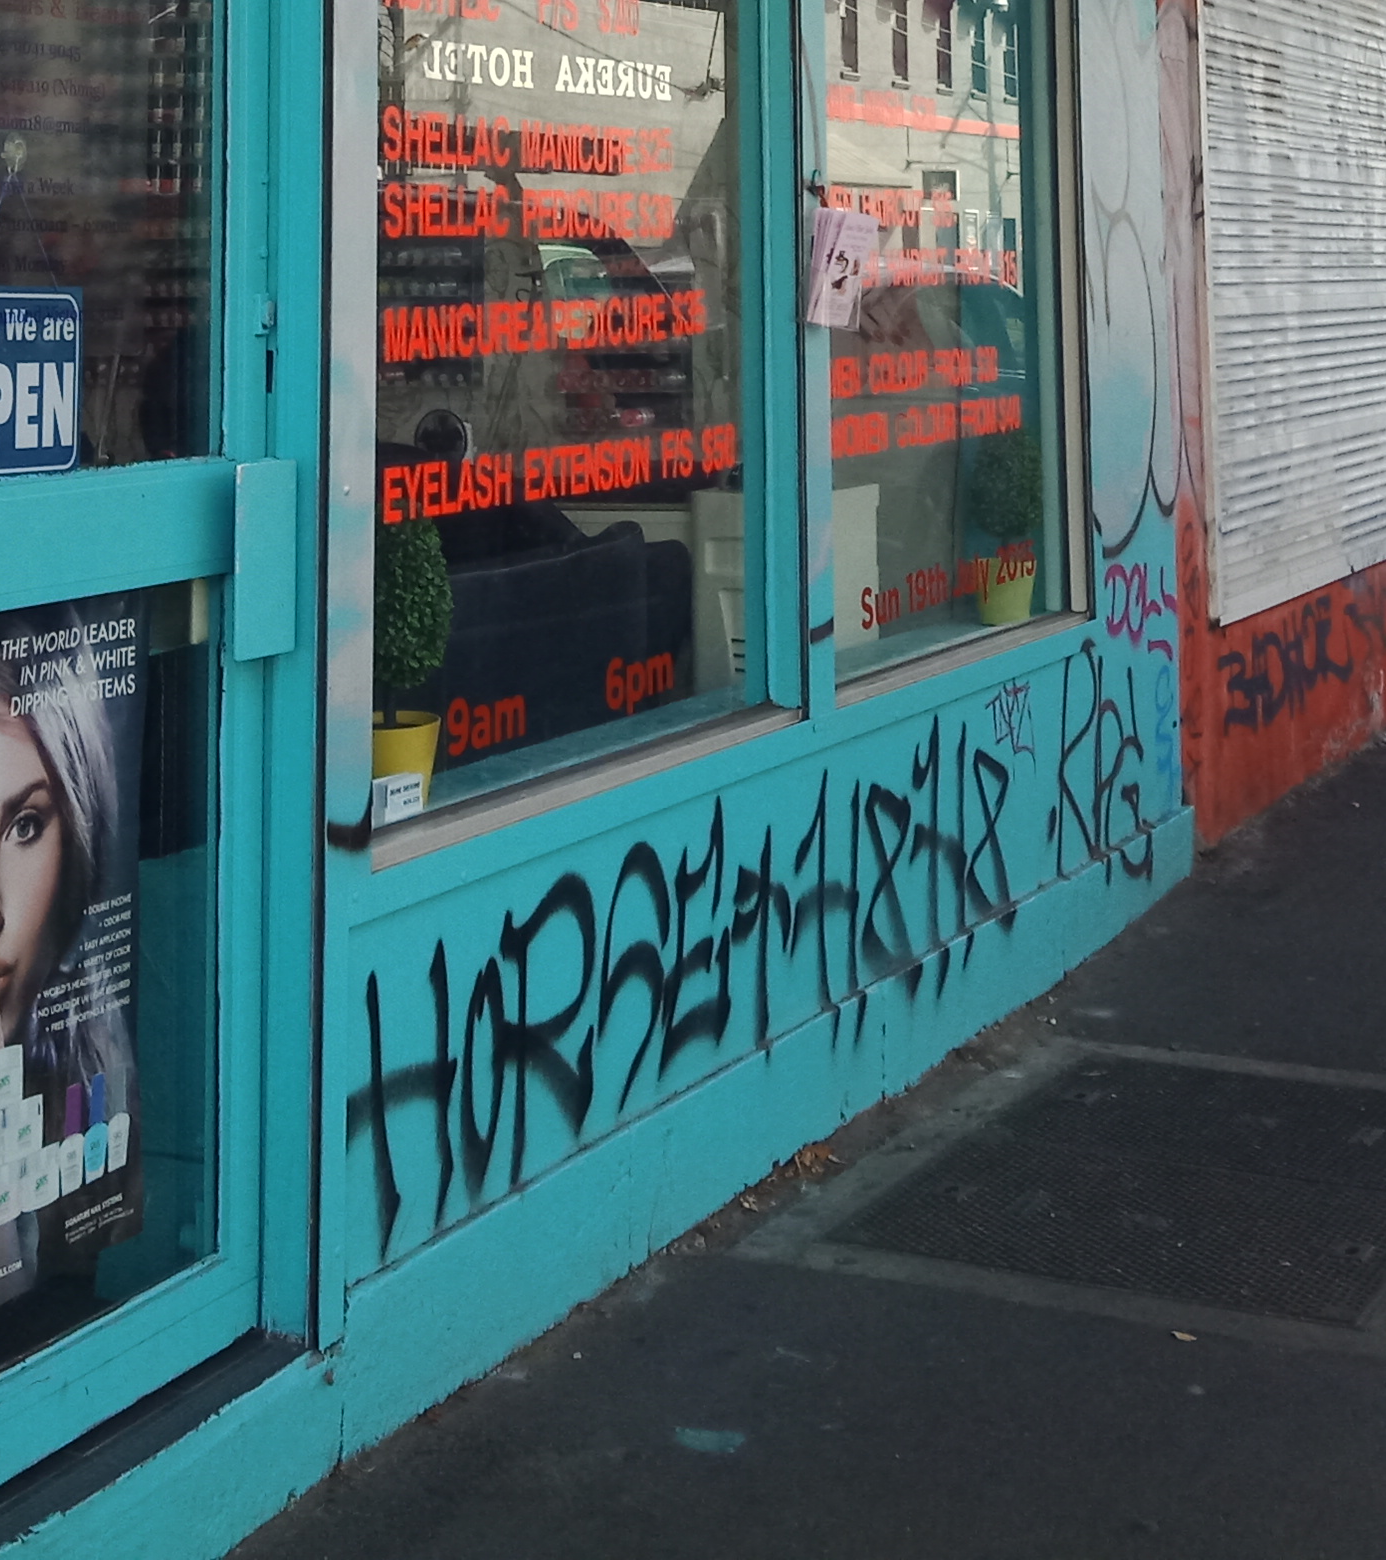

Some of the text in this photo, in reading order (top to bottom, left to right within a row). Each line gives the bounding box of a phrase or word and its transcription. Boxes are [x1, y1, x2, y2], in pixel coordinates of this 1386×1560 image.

[383, 105, 510, 168] SHELLAC
[521, 119, 635, 175] MANICURE
[384, 182, 510, 239] SHELLAC
[522, 188, 635, 239] PEDICURE
[5, 308, 37, 341] We
[43, 316, 75, 342] are
[383, 301, 530, 363] MANICURE
[551, 293, 668, 351] PEDICURE
[383, 453, 513, 525] EYELASH
[524, 437, 652, 503] EXTENSION
[861, 586, 901, 630] Sun
[905, 562, 949, 615] 19th
[952, 554, 990, 605] July
[1, 618, 136, 662] THE WORLD LEADER
[19, 646, 136, 687] IN PINK & WHITE
[10, 673, 136, 718] DIPPING YSTEMS
[446, 653, 674, 757] 9am 6pm
[38, 1007, 49, 1018] NO
